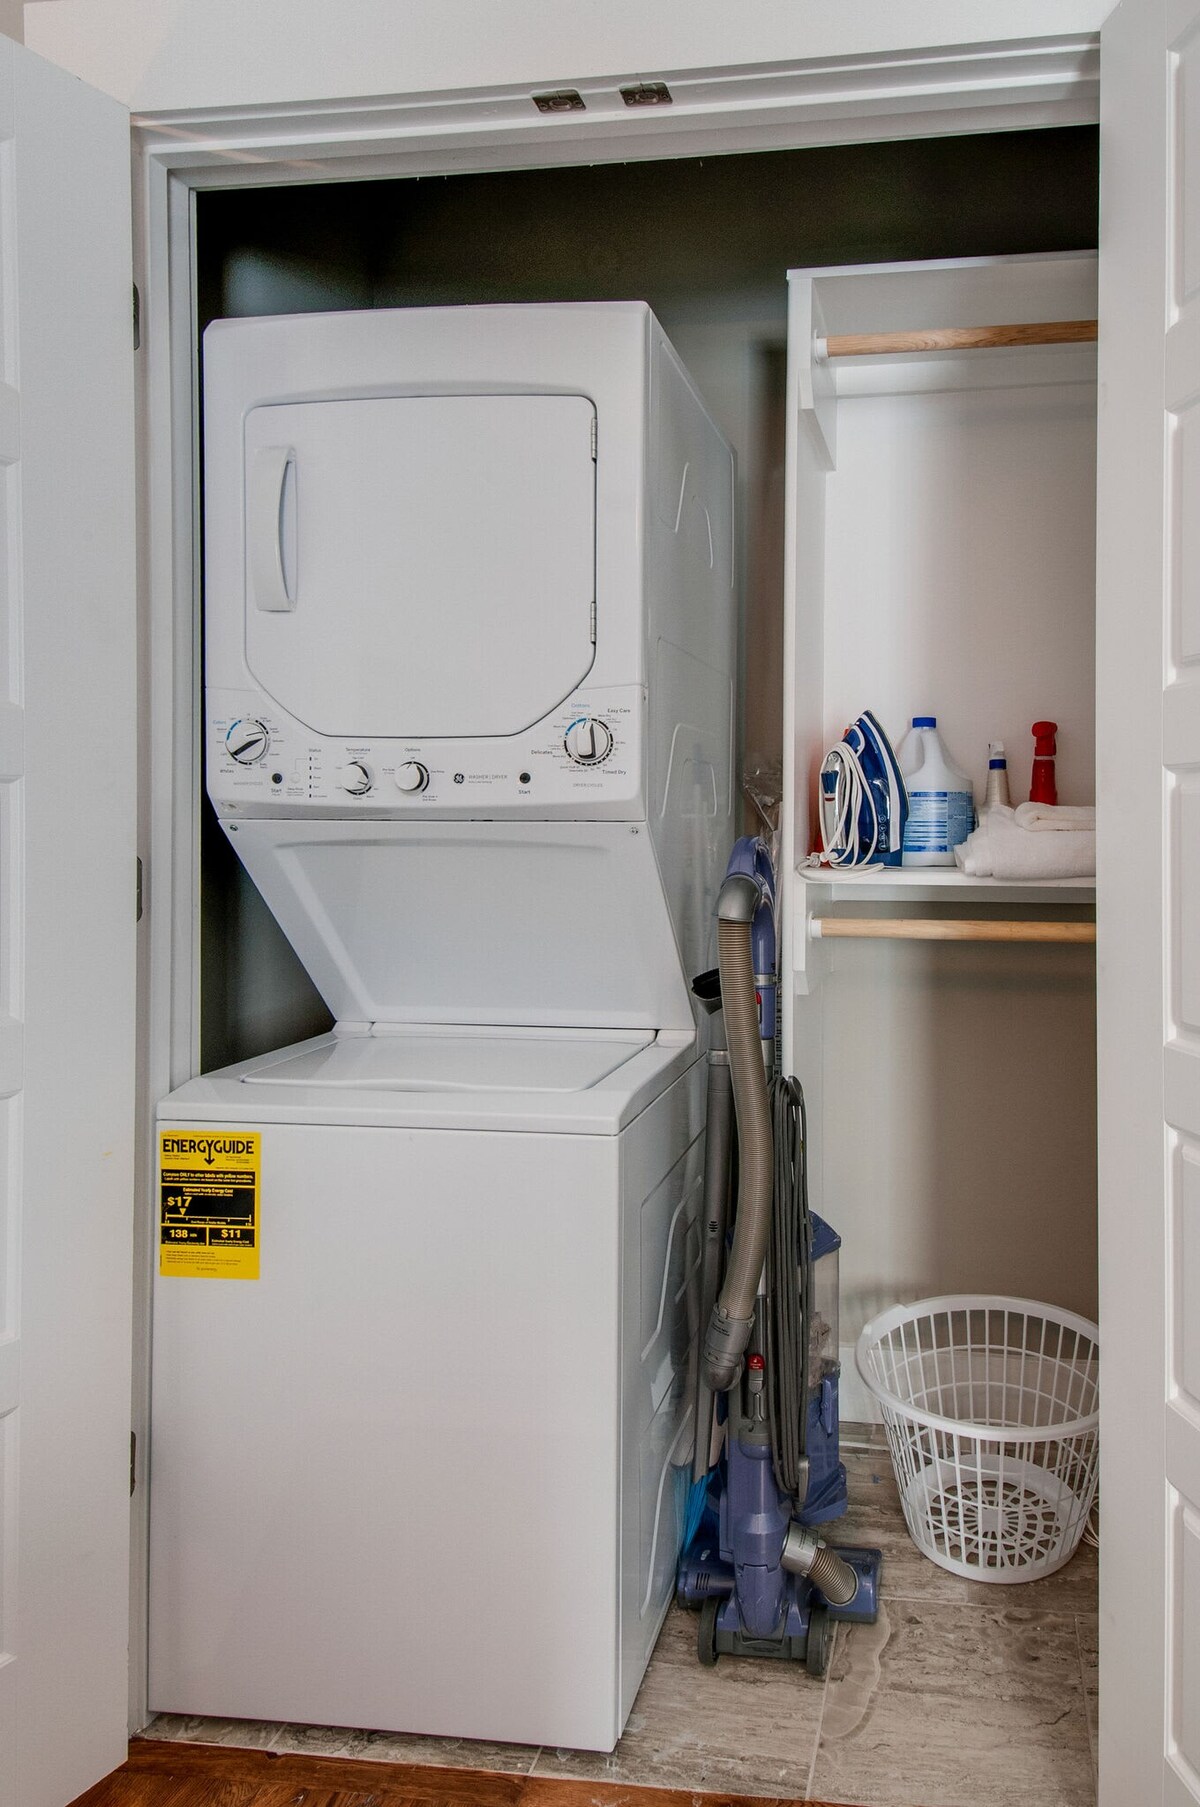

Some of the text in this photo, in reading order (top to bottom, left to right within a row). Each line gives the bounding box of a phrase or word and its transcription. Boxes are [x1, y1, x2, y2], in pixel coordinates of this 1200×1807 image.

[162, 1139, 255, 1155] ENERGYGUIDE
[167, 1196, 193, 1207] $17
[169, 1229, 188, 1238] 138
[221, 1229, 240, 1238] $11
